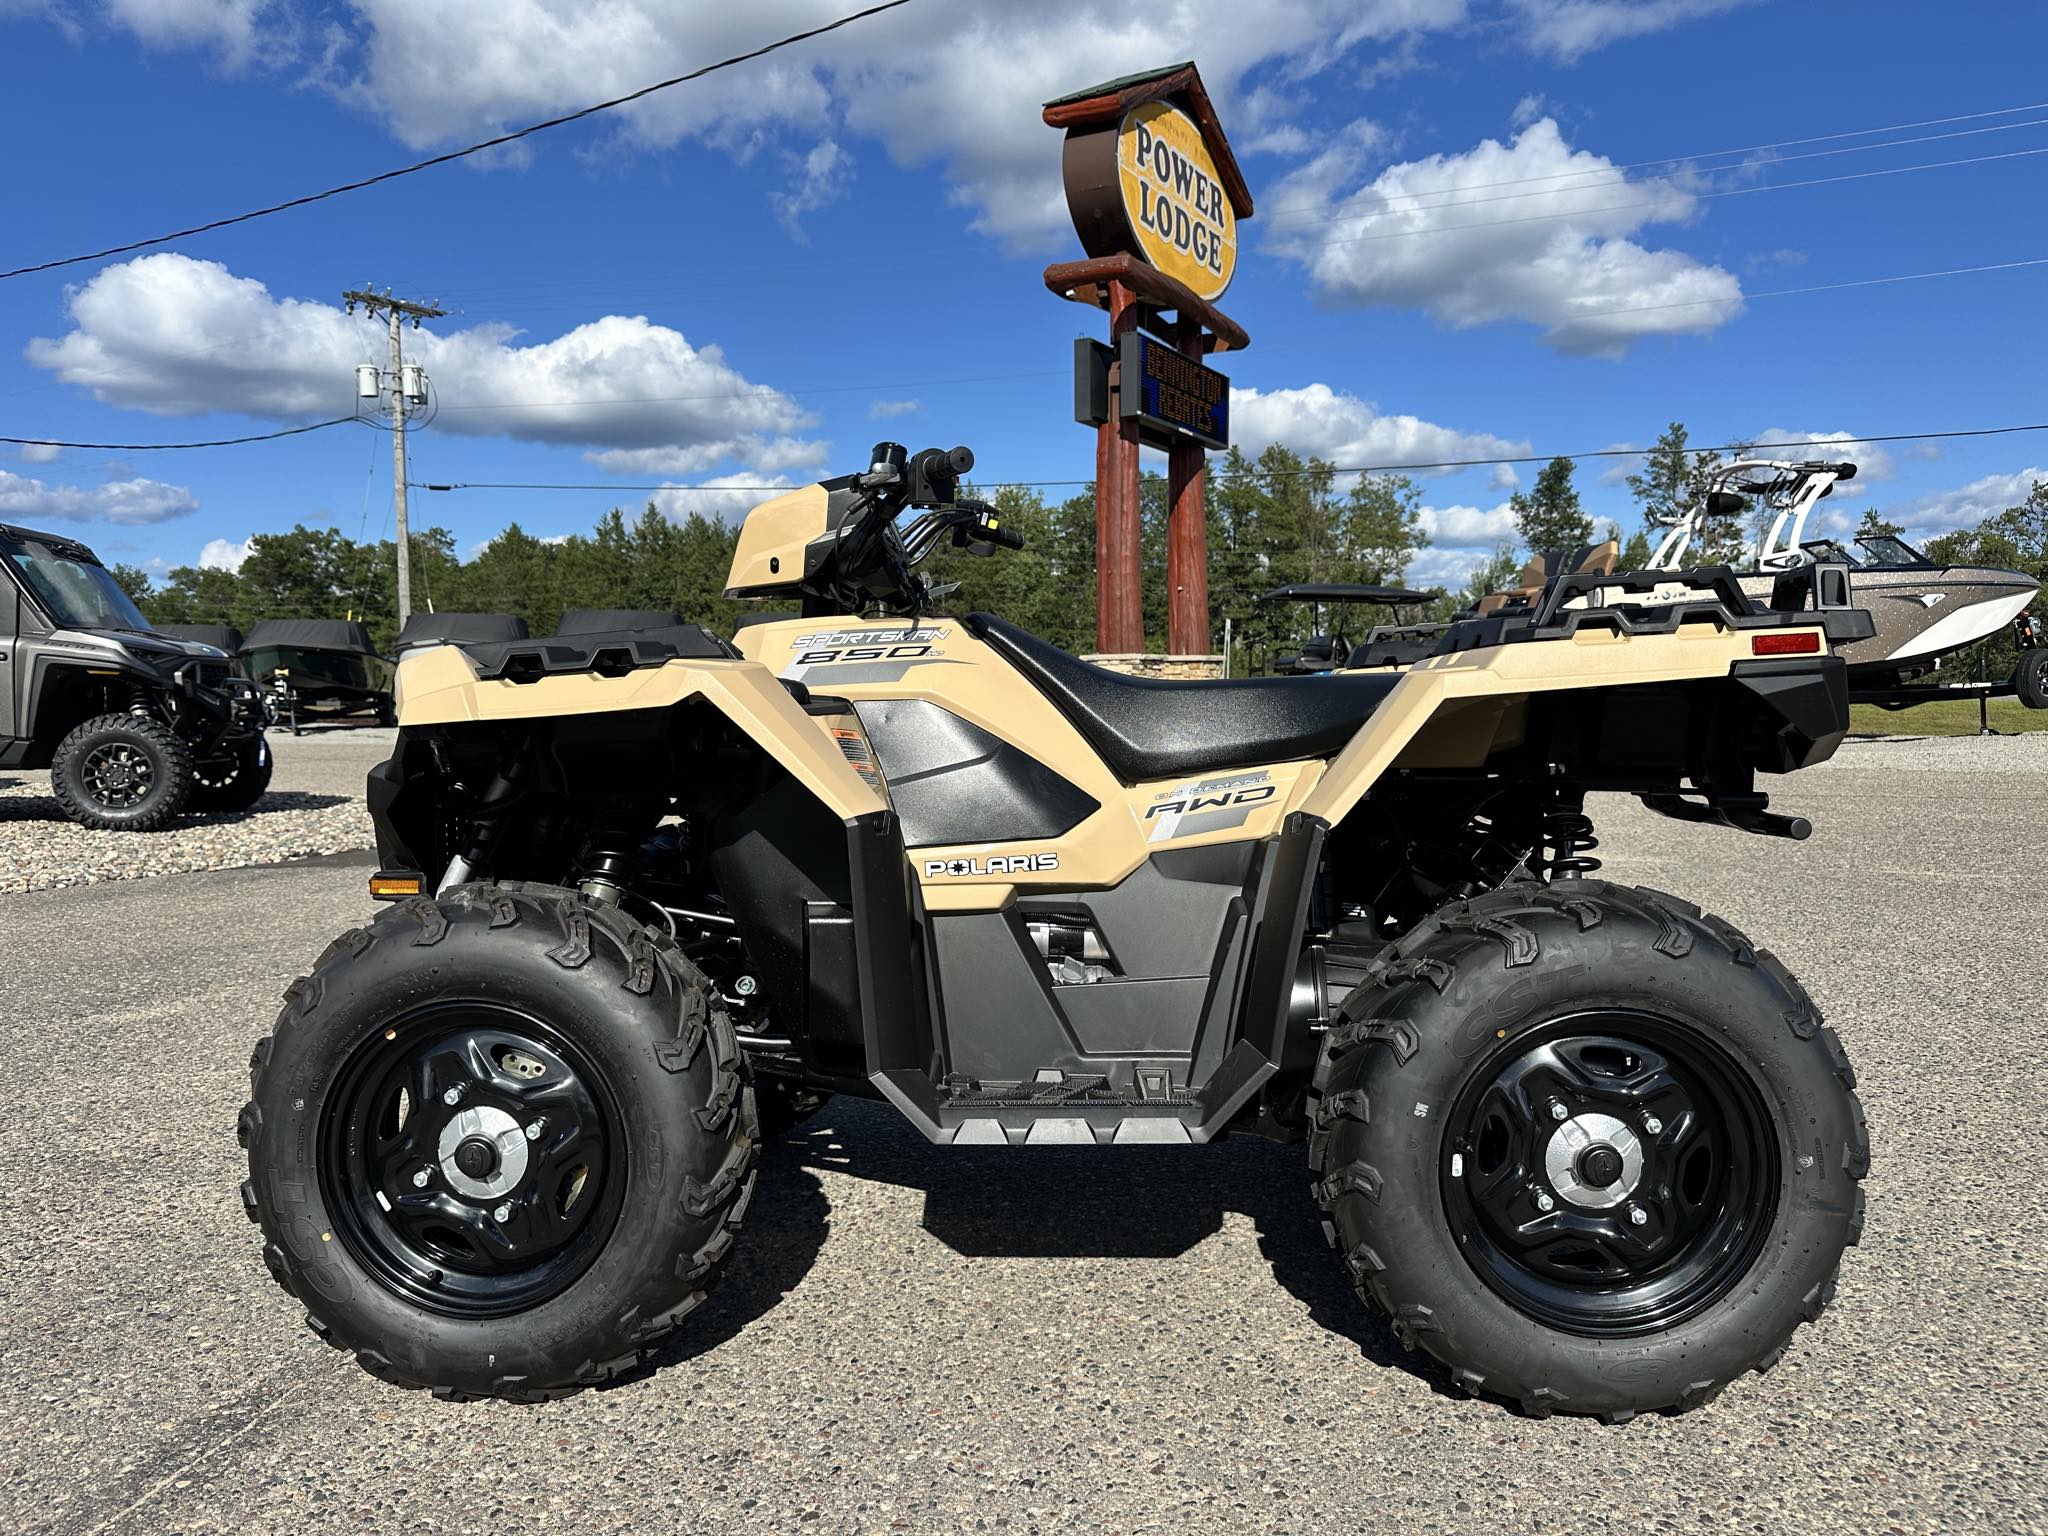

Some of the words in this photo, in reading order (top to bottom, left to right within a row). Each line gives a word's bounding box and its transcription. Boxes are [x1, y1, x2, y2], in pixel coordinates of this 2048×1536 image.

[1136, 120, 1224, 229] POWER
[1139, 180, 1223, 275] LODGE
[1159, 382, 1213, 433] REBATES
[790, 628, 952, 649] SPORTSMAN
[796, 645, 933, 665] 850
[1144, 785, 1277, 819] AWD
[1155, 789, 1183, 801] ON
[1189, 775, 1272, 795] DEMAND
[924, 852, 1060, 878] POLARIS
